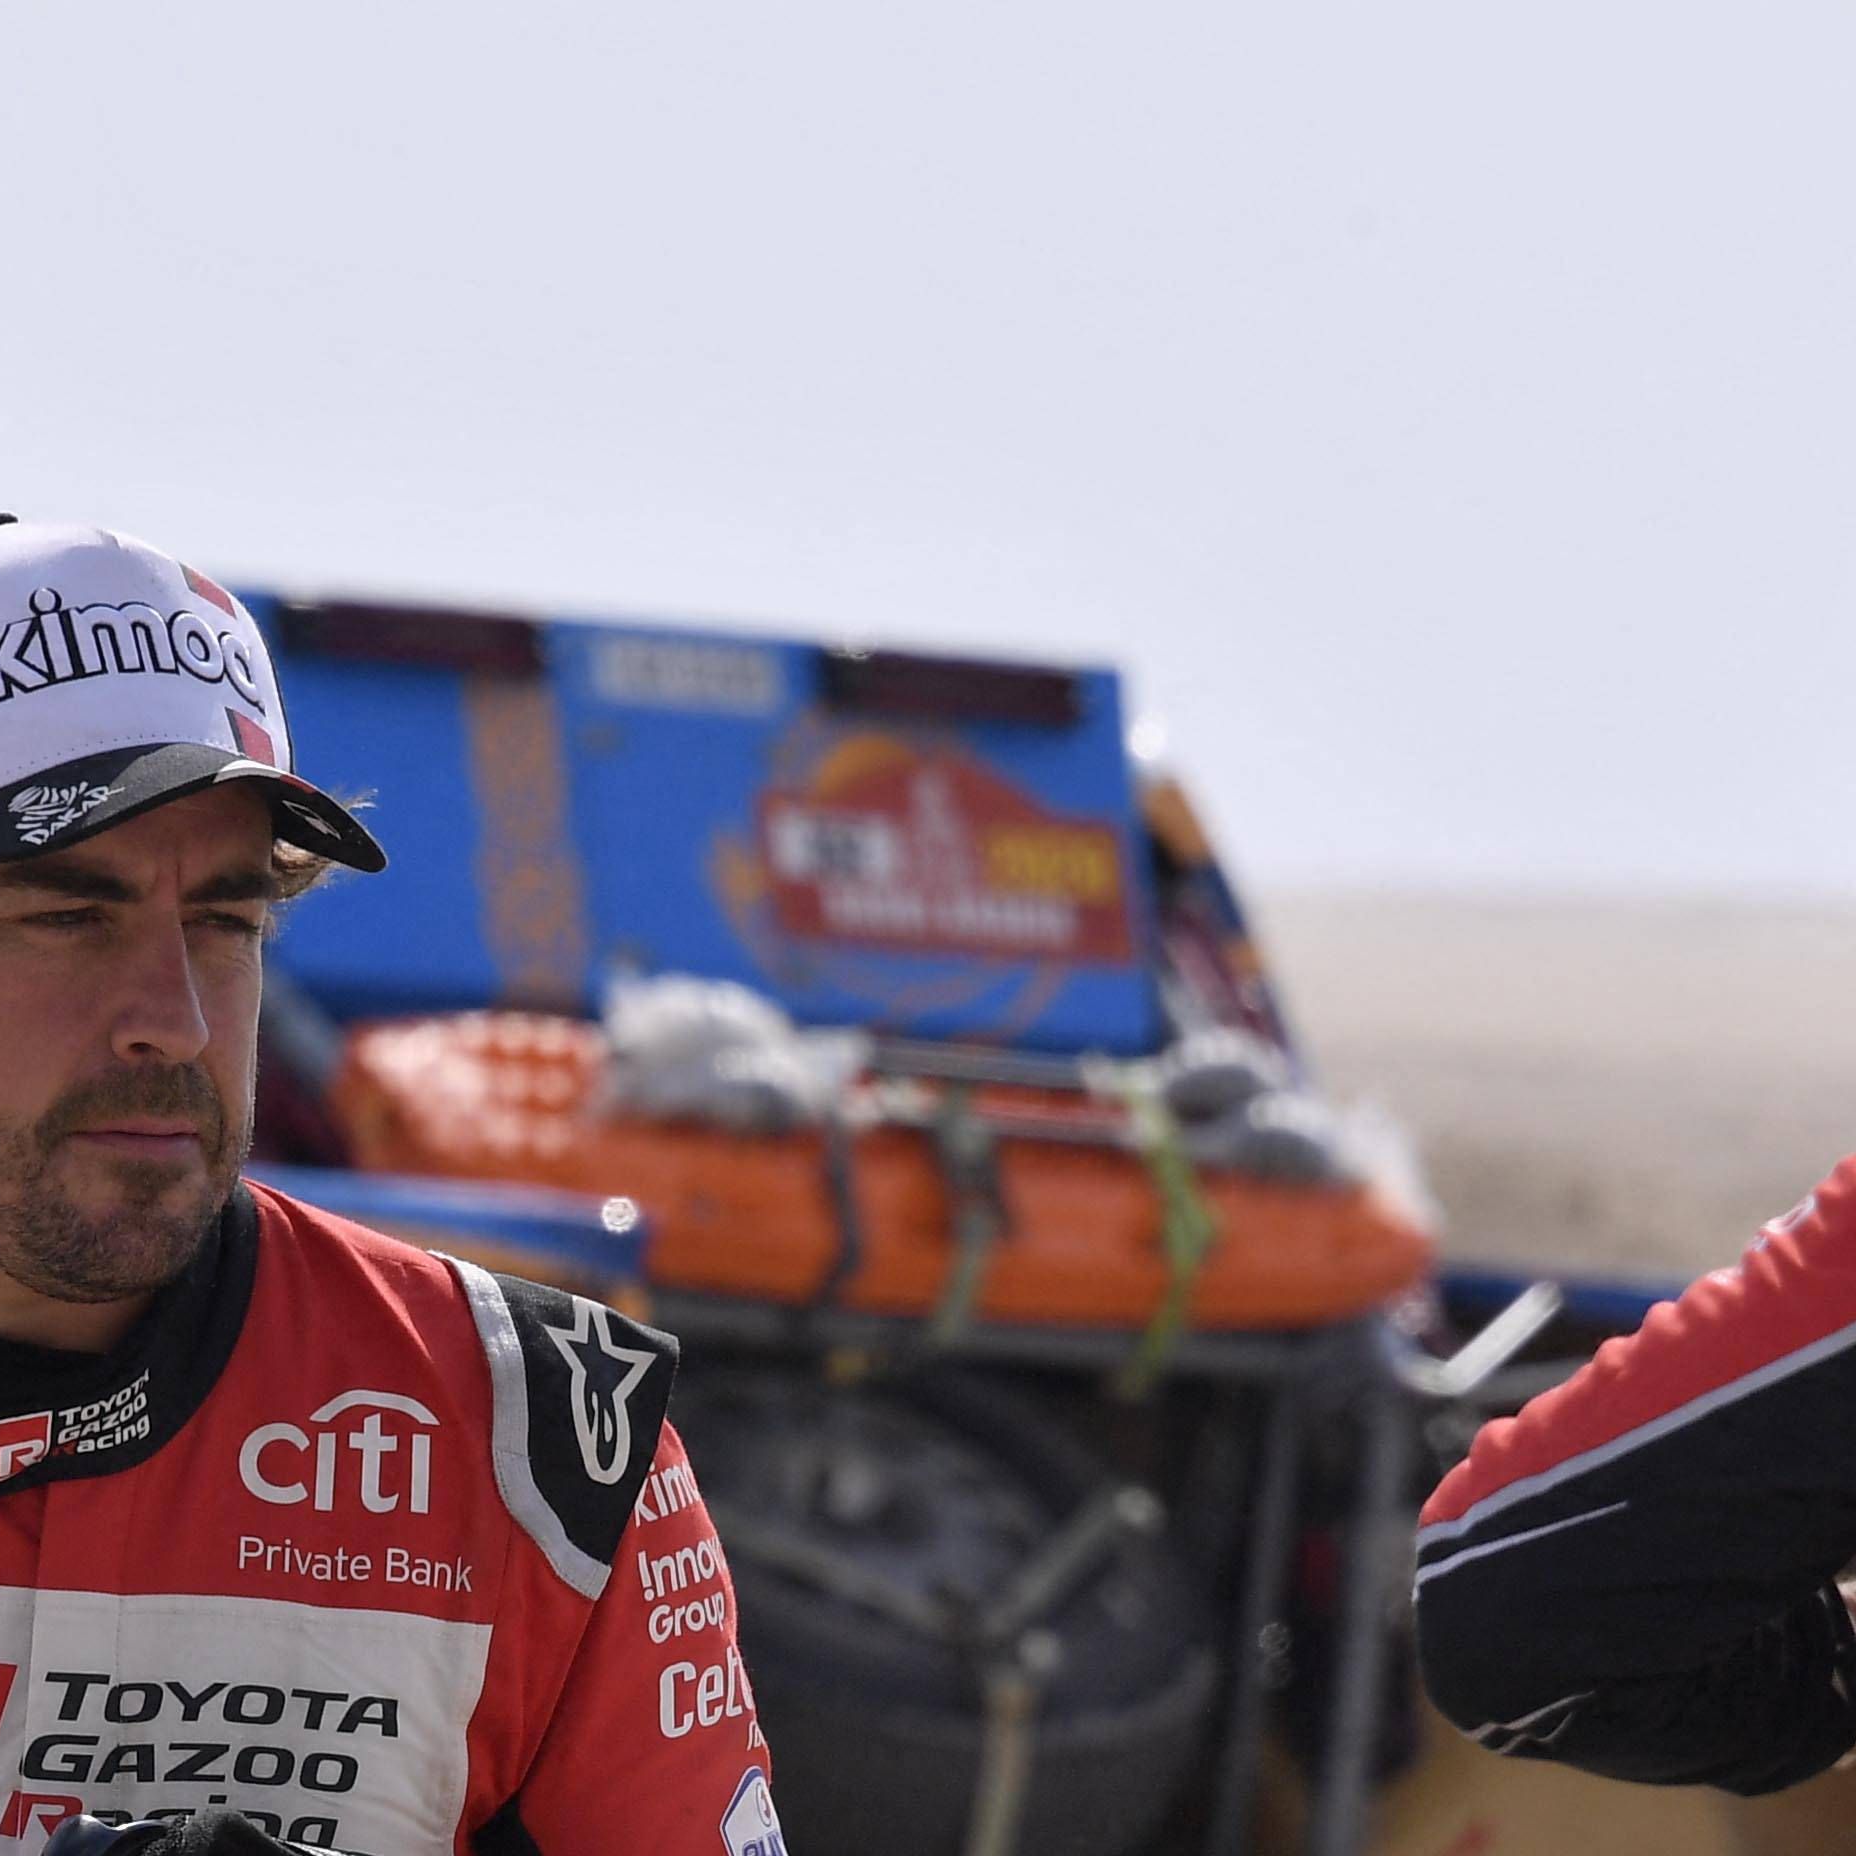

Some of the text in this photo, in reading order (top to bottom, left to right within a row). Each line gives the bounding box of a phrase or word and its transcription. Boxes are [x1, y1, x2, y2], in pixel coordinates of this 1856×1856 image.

[57, 1392, 147, 1445] GAZOO
[238, 1388, 441, 1515] citi
[238, 1535, 473, 1593] Private Bank
[44, 1671, 400, 1739] TOYOTA
[20, 1733, 360, 1793] GAZOO
